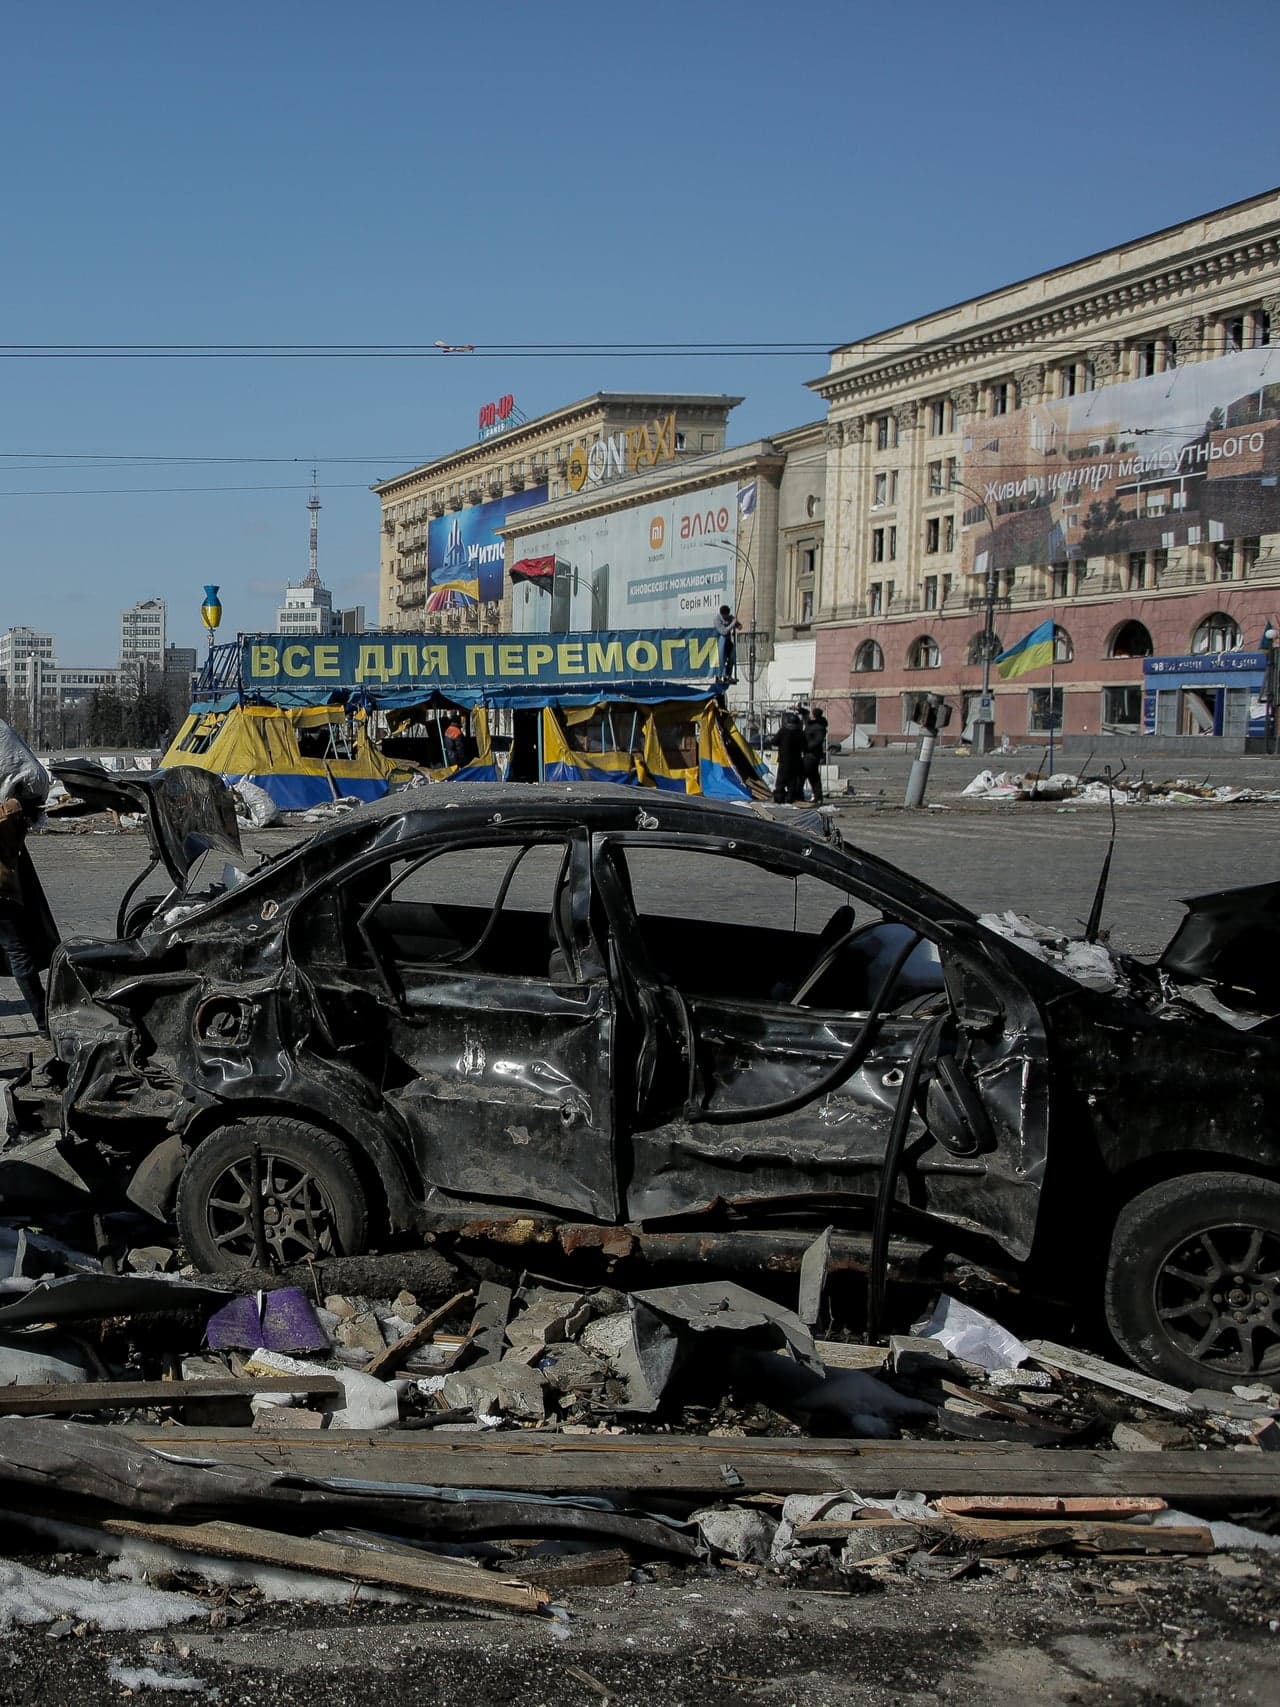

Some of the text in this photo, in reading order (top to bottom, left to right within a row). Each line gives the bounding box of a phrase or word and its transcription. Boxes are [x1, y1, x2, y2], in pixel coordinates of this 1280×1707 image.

[680, 598, 701, 612] Серія
[714, 594, 720, 605] 11
[251, 636, 721, 683] ВСЕ ДЛЯ ПЕРЕМОГИ
